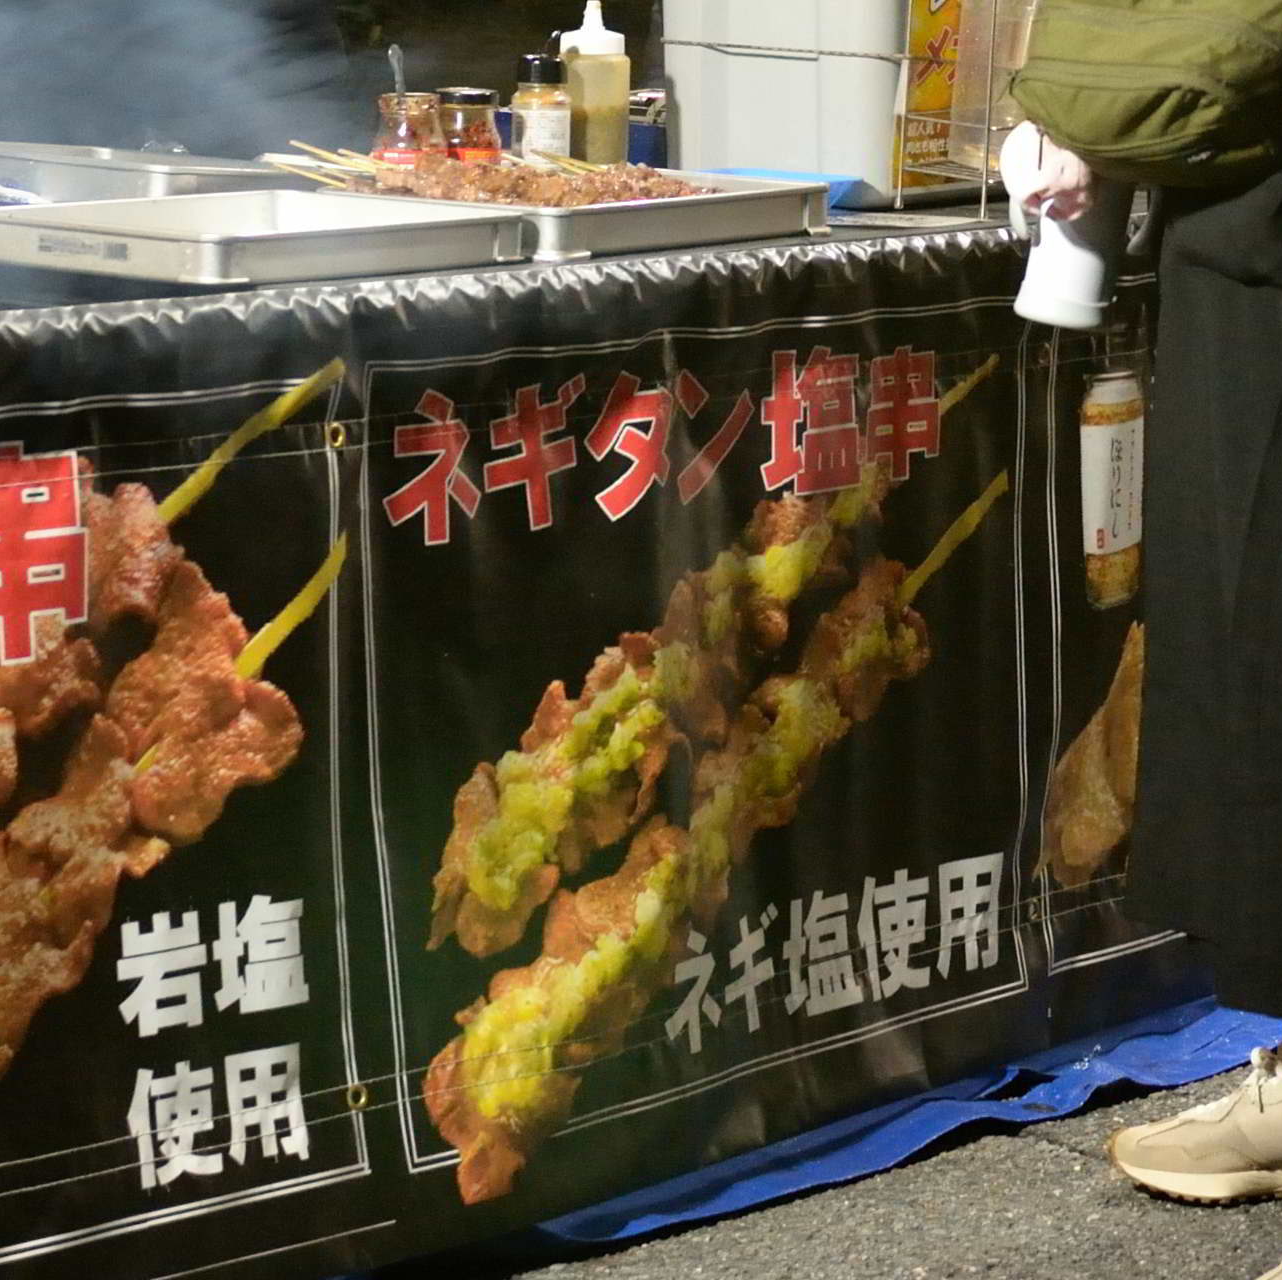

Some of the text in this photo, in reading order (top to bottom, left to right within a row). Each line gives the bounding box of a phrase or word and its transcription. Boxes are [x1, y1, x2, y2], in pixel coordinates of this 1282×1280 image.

[383, 345, 940, 548] ネギタン塩串
[117, 893, 310, 1039] 岩塩
[665, 853, 1005, 1055] ネギ塩使用
[126, 1042, 310, 1188] 使用
